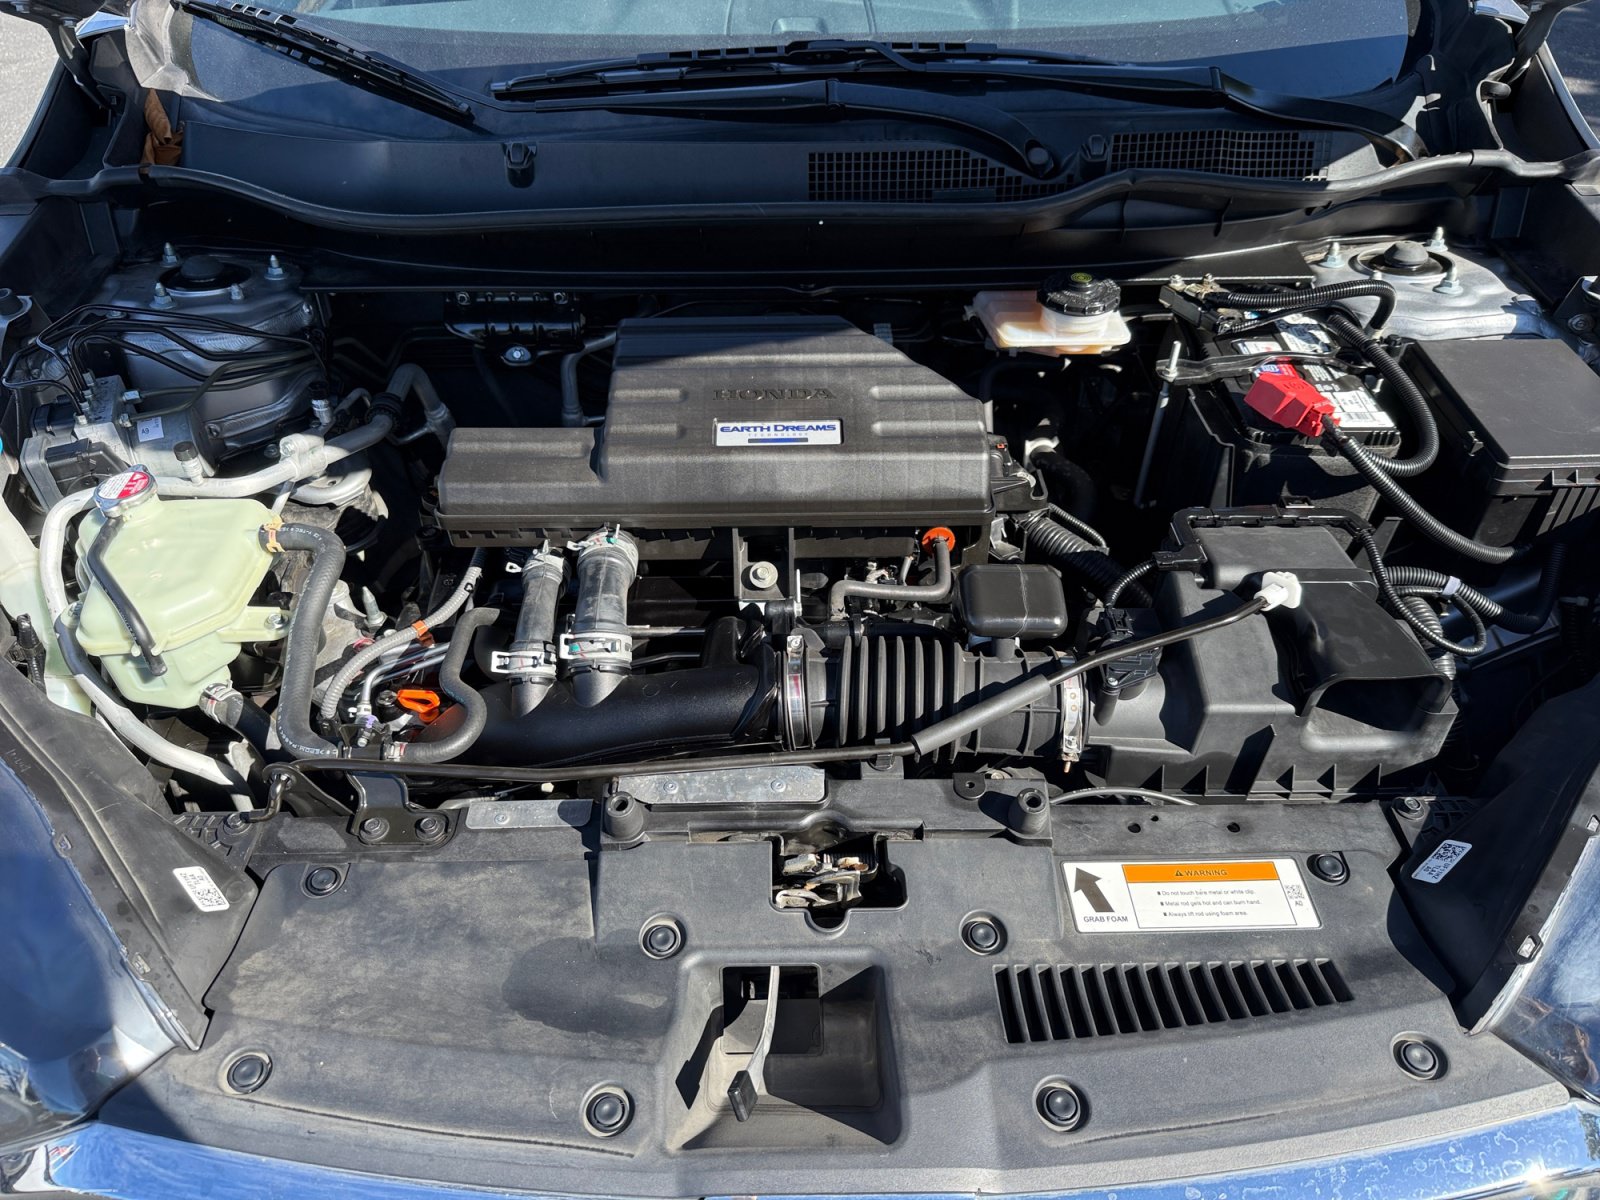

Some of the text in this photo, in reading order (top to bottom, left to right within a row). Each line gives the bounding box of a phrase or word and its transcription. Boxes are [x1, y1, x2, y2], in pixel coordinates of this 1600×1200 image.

[713, 388, 836, 401] HONDA
[720, 425, 770, 433] EARTH
[1168, 911, 1187, 919] Always
